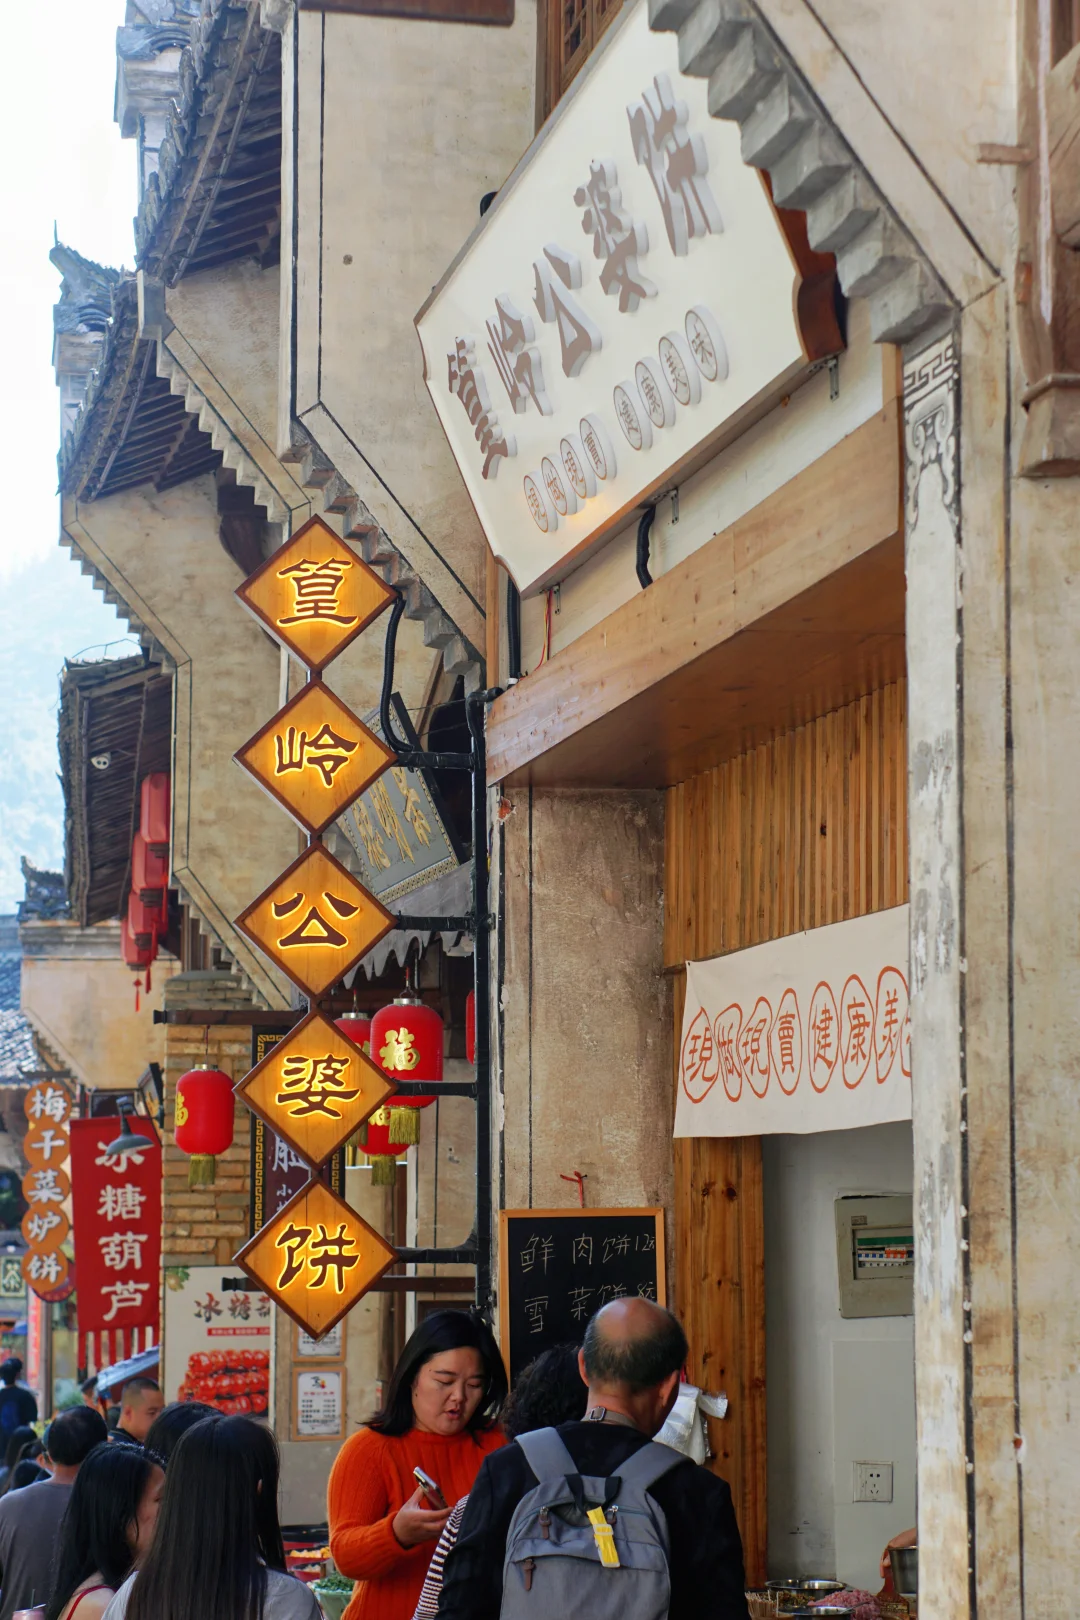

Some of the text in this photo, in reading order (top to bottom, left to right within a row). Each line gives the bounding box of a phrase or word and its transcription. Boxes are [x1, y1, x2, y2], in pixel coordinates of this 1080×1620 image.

[447, 72, 724, 480] 篁岭公婆饼
[271, 556, 362, 1295] 篁岭公婆饼
[379, 1027, 421, 1071] 福
[26, 1086, 67, 1284] 梅干菜炉饼
